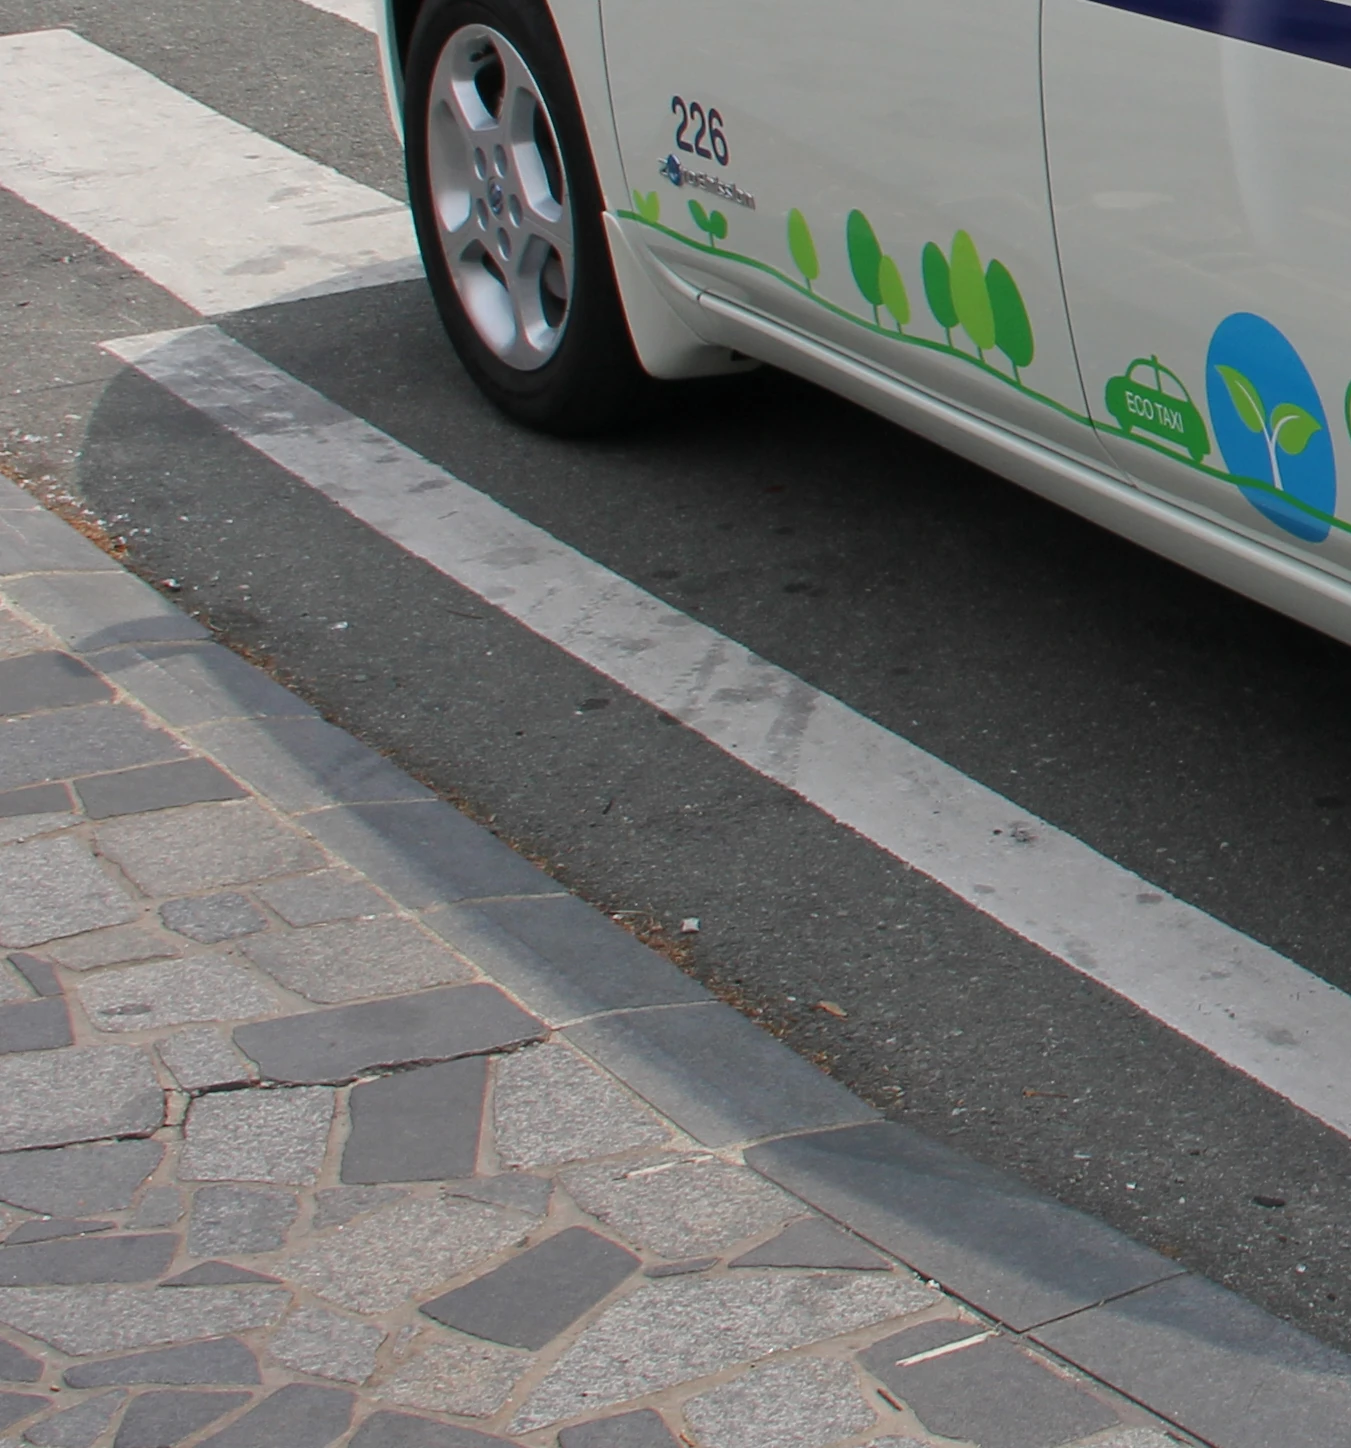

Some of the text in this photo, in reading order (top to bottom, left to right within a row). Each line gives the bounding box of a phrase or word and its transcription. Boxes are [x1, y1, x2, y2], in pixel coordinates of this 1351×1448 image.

[671, 95, 730, 167] 226
[1124, 390, 1185, 434] ECO TAXI
